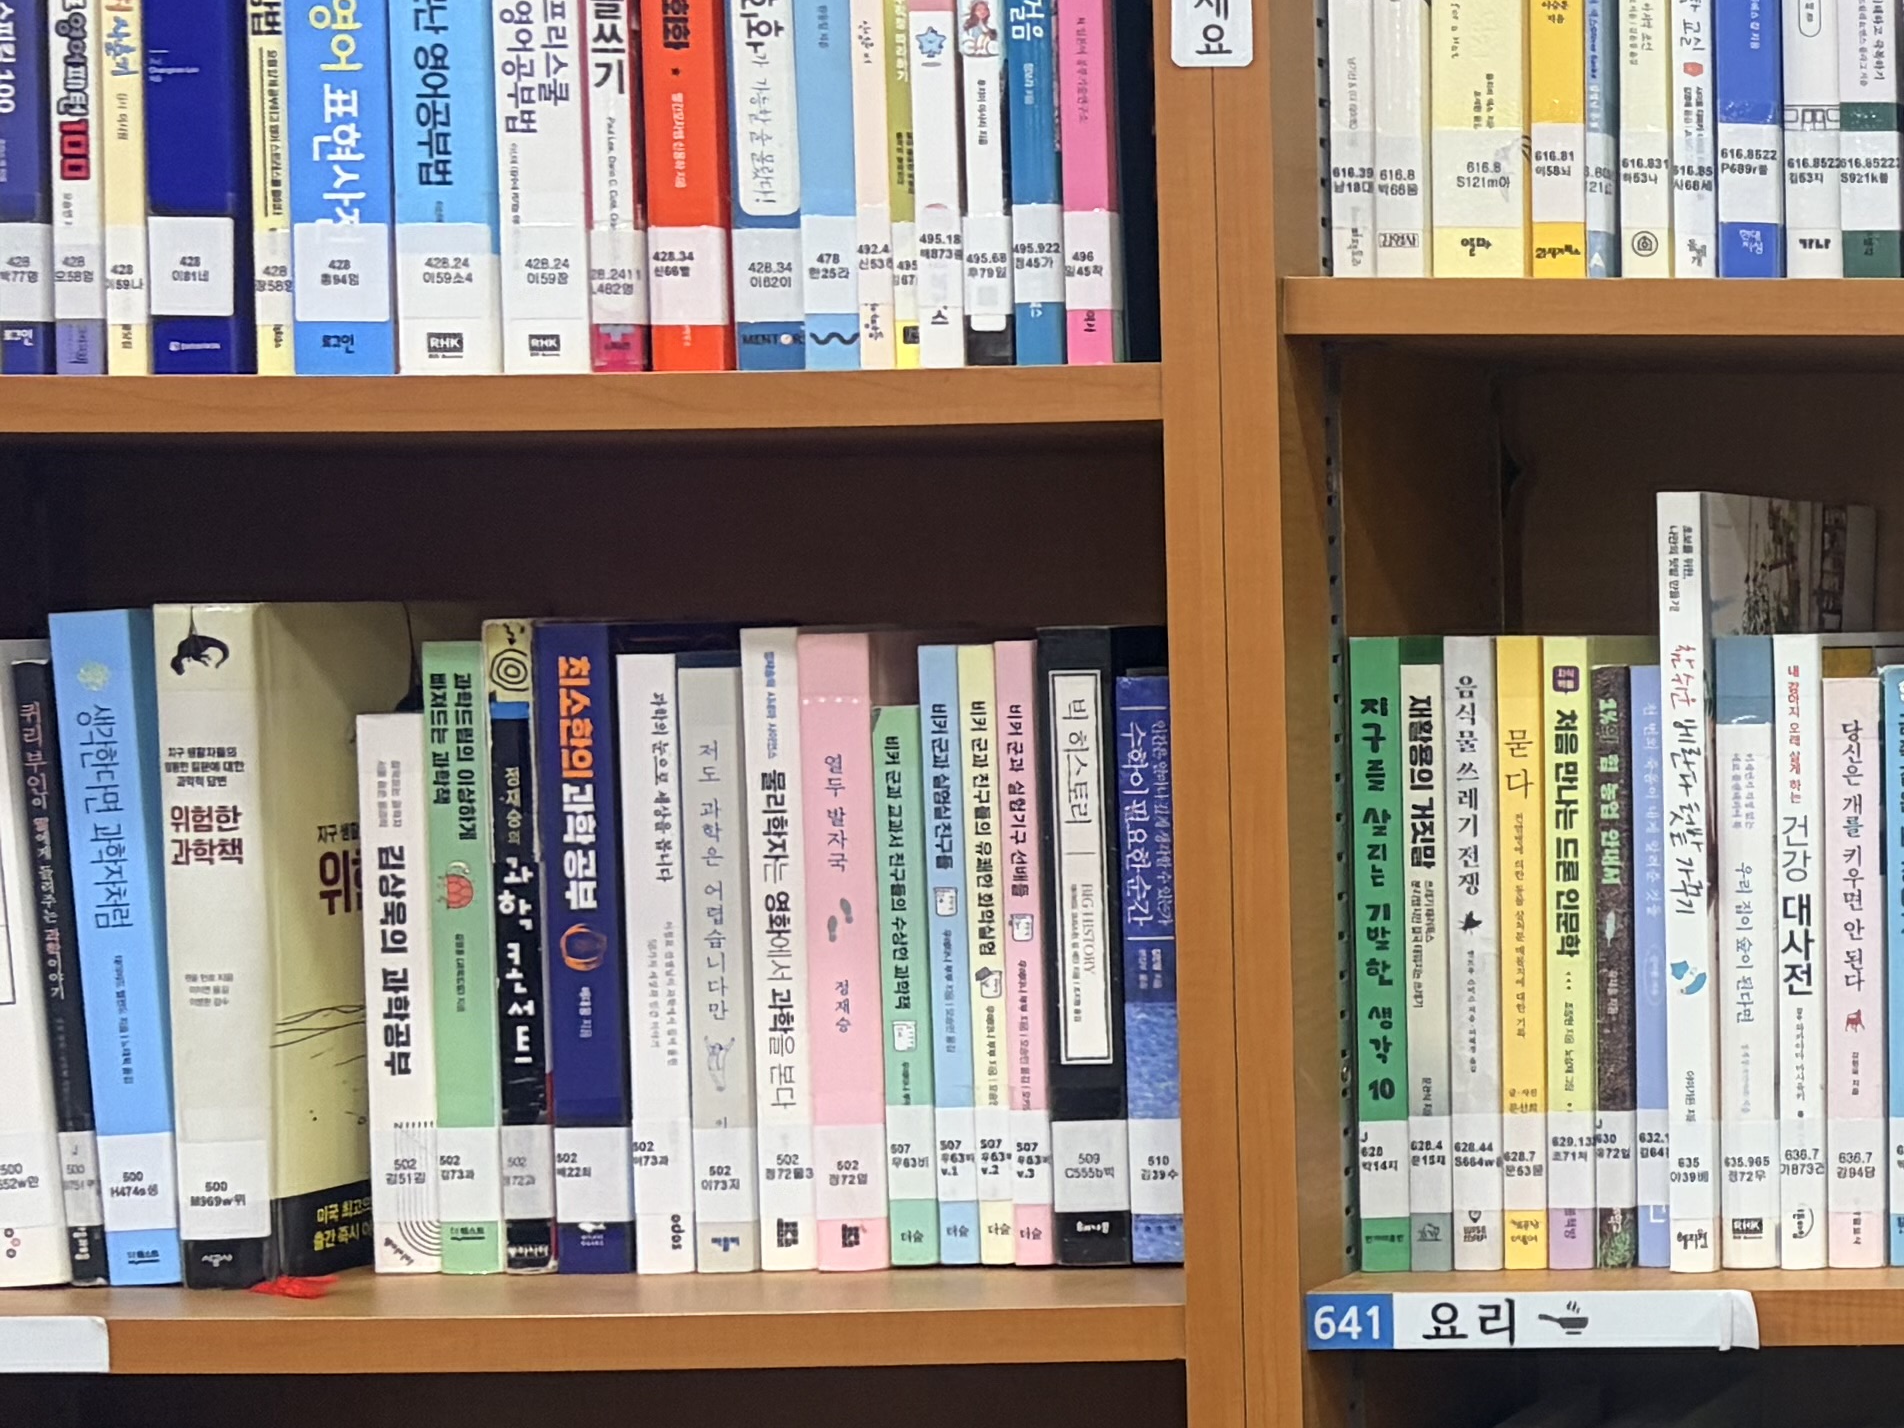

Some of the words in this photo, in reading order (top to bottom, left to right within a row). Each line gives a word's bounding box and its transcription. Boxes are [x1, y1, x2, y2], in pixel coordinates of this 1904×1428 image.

[1535, 151, 1574, 161] 616.81
[1467, 162, 1501, 173] 616.8
[425, 258, 469, 268] 428.24
[430, 337, 460, 348] RHK
[559, 657, 595, 778] 최소한의
[171, 805, 242, 832] 위험한
[171, 838, 243, 865] 과학책
[563, 782, 597, 910] 과학공부
[1838, 1152, 1872, 1163] 636.7
[1315, 1306, 1379, 1339] 641
[1423, 1298, 1515, 1346] 요리
